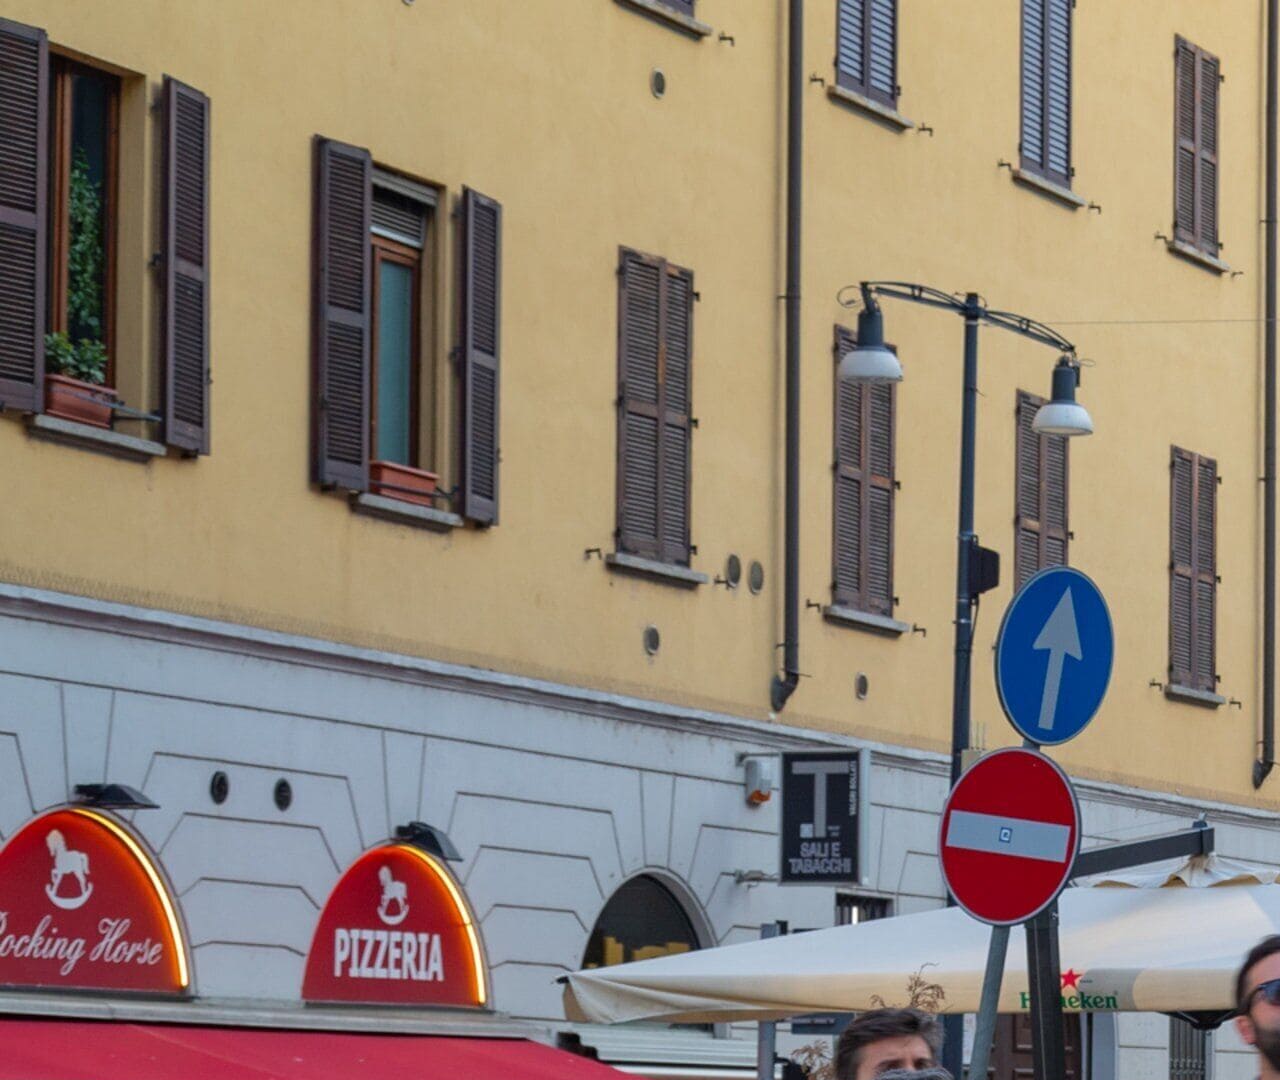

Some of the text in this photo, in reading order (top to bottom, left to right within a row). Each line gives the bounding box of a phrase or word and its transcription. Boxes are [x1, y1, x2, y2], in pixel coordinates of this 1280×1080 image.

[800, 841, 841, 857] SALI E
[789, 858, 852, 874] TABACCHI
[89, 918, 164, 966] Horse
[334, 928, 445, 982] PIZZERIA
